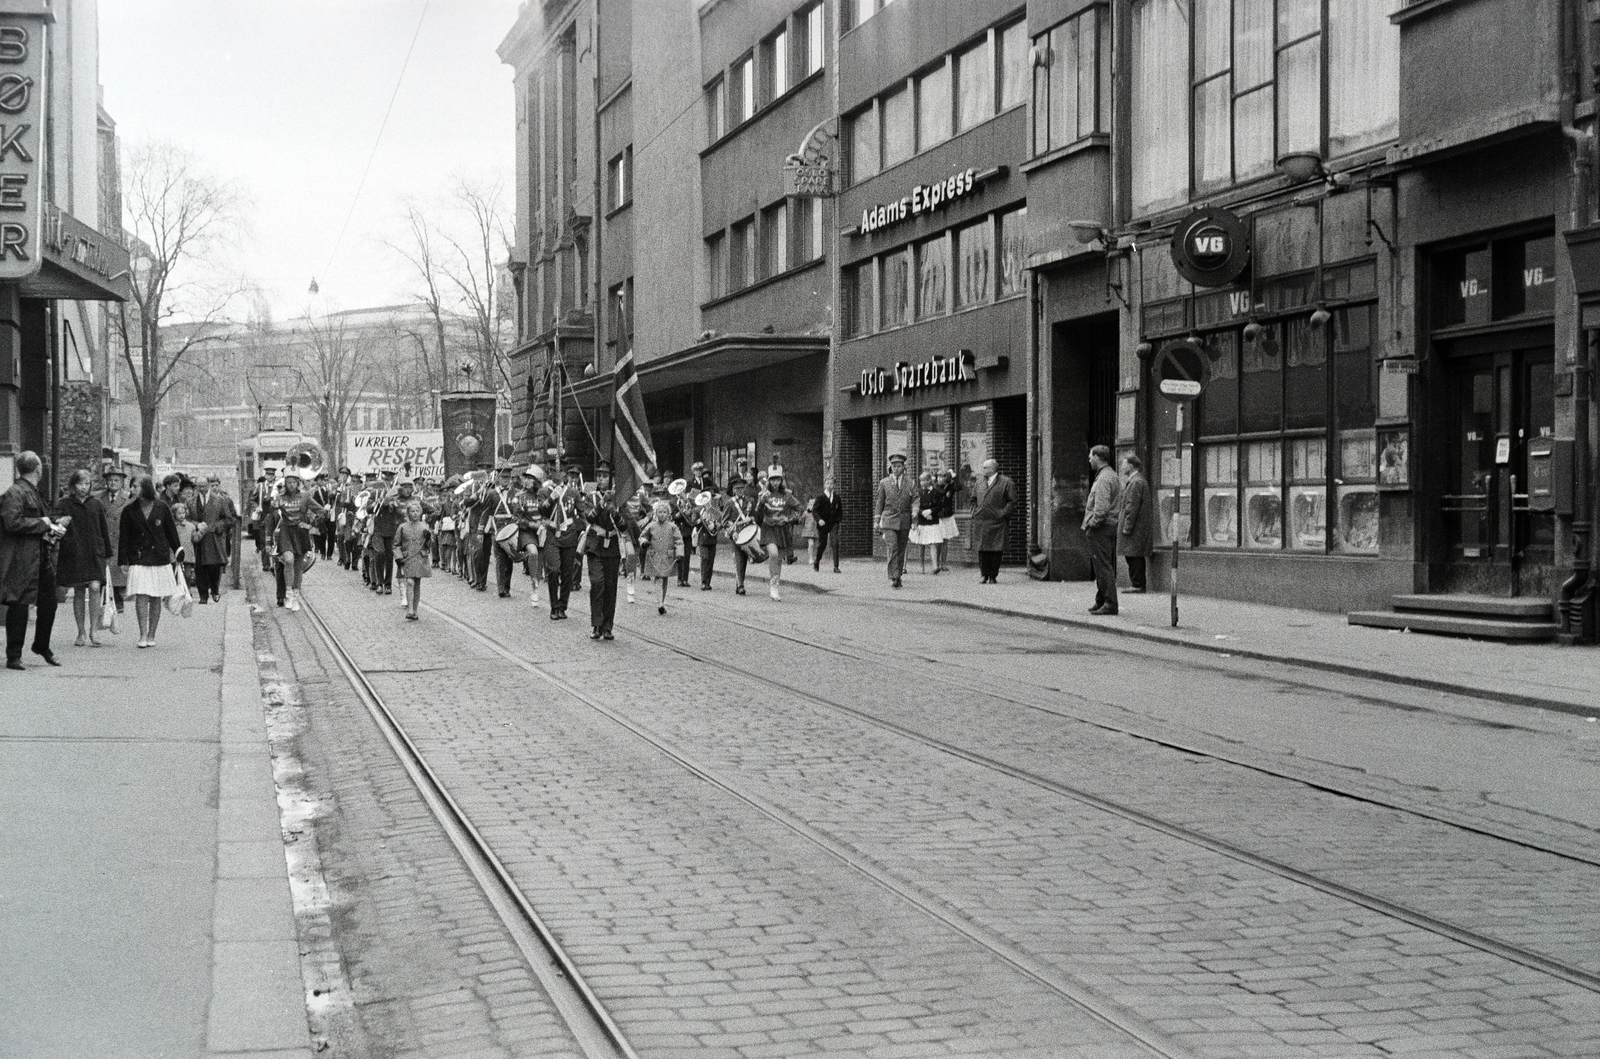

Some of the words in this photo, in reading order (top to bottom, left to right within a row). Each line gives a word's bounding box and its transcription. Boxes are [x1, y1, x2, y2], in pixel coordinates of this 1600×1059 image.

[0, 26, 34, 261] BØKER
[796, 168, 827, 177] OSLO
[861, 197, 907, 234] Adams
[912, 168, 974, 213] Express
[1195, 236, 1224, 253] VG
[860, 366, 885, 395] Oslo
[893, 349, 967, 396] Sparebank
[354, 437, 365, 448] VI
[366, 436, 410, 448] KREVER
